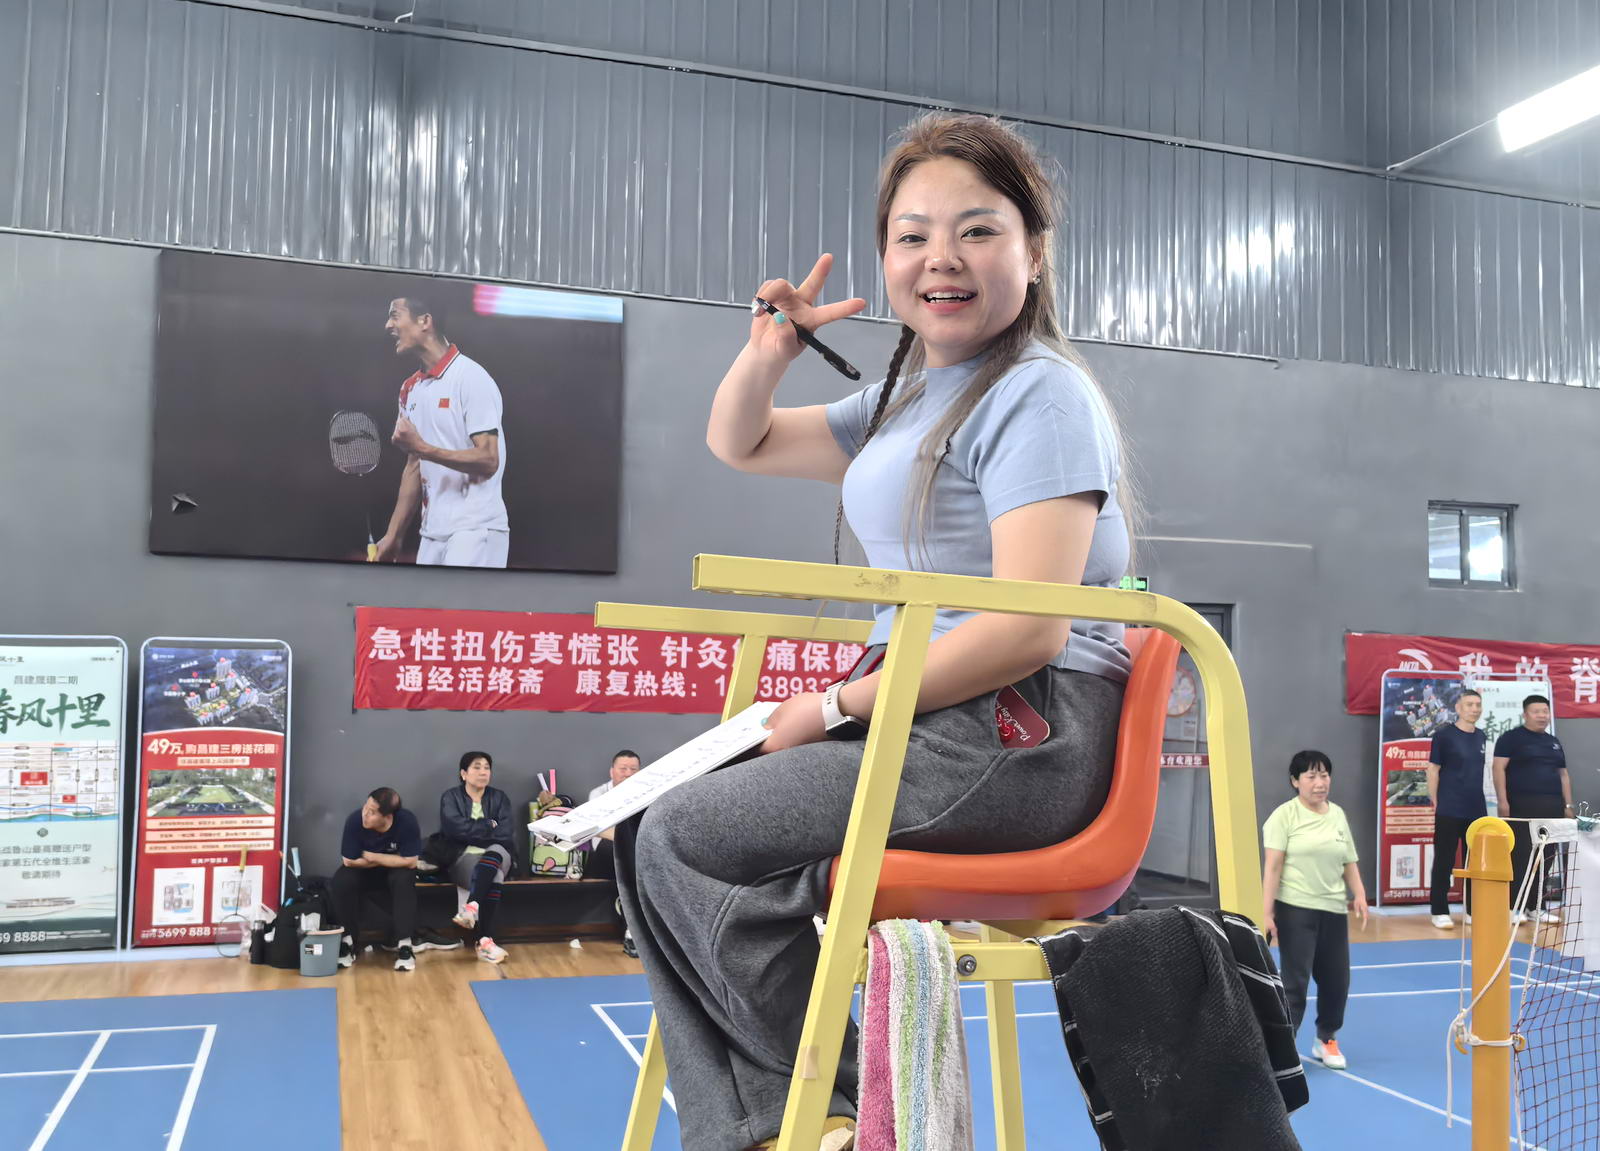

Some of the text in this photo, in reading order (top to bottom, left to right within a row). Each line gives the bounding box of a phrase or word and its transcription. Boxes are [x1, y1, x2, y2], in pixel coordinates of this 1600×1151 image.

[368, 626, 864, 673] 急性扭伤莫慌张 针灸痛保健
[396, 664, 544, 695] 通经活络斋
[14, 931, 46, 943] 8888
